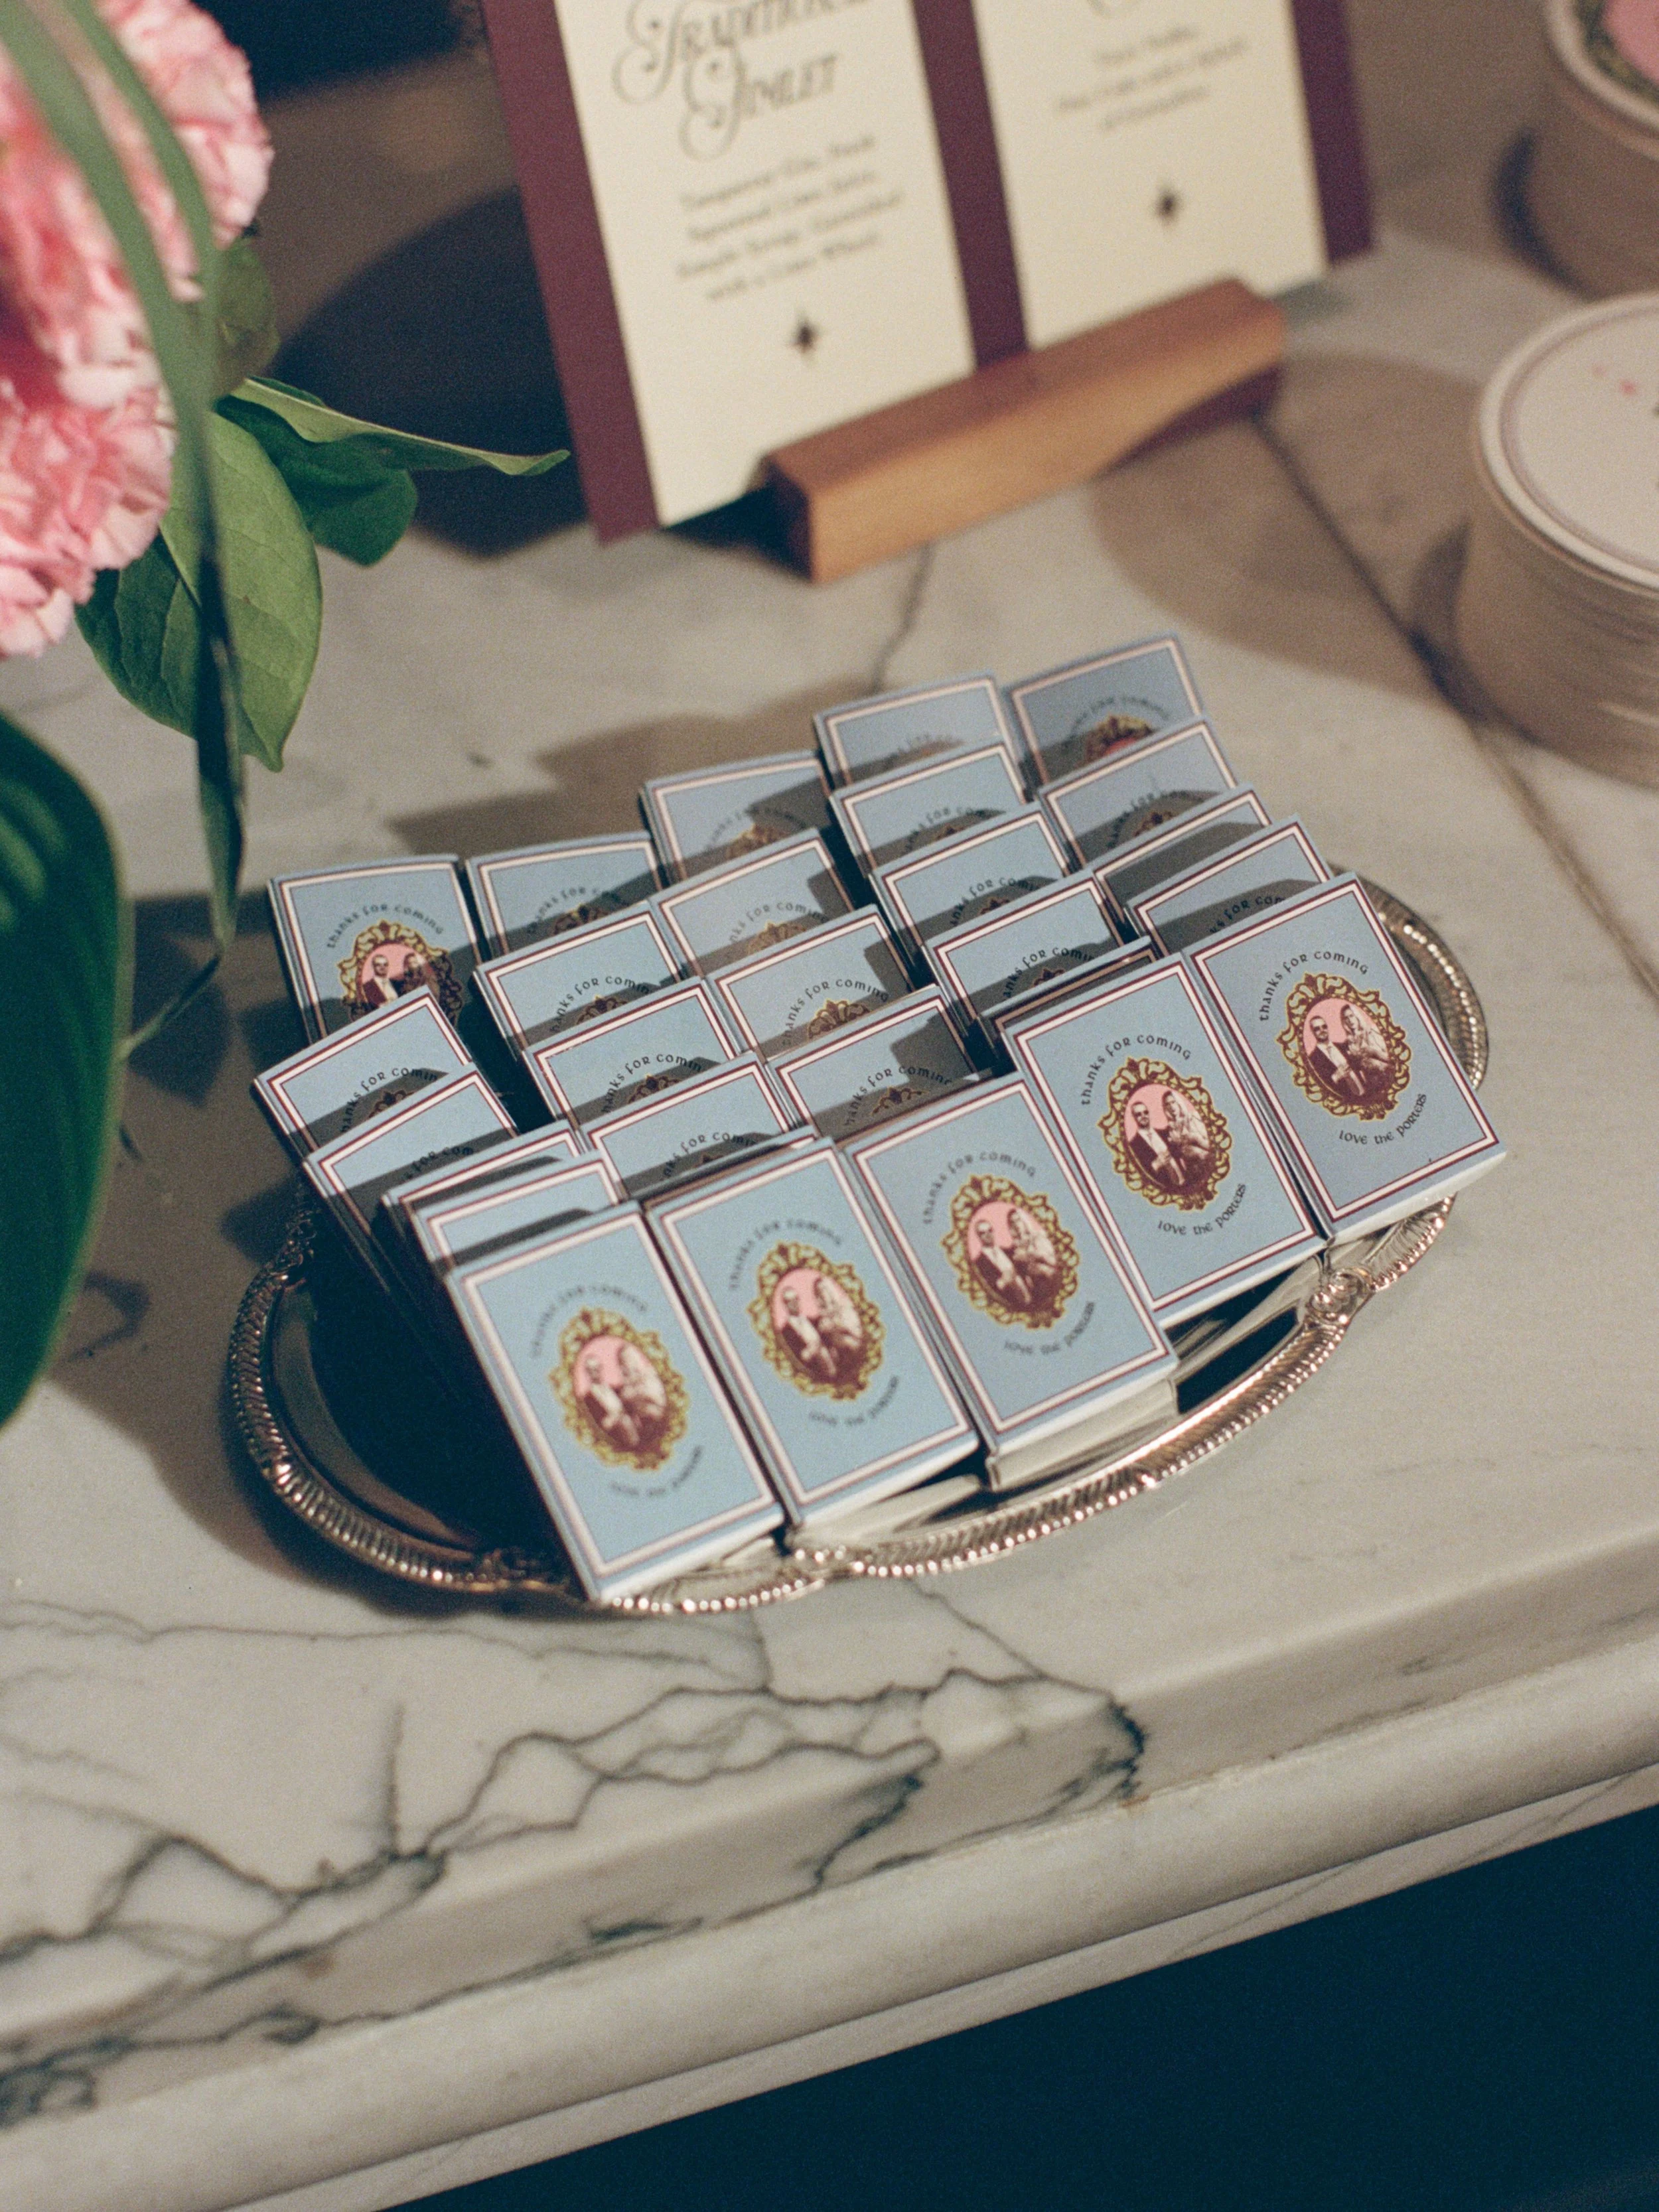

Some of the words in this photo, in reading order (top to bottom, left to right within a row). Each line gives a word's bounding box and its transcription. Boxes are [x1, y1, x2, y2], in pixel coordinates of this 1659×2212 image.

[605, 975, 650, 994] comin
[804, 981, 830, 999] for
[835, 979, 889, 1003] coming
[1260, 972, 1283, 1021] thanks
[1283, 953, 1308, 974] for
[1315, 951, 1369, 975] coming
[624, 1056, 650, 1075] for
[656, 1054, 702, 1072] comin
[1081, 1056, 1106, 1105] thanks
[1106, 1035, 1131, 1058] for
[1137, 1034, 1192, 1061] coming
[360, 1071, 385, 1091] for
[390, 1067, 439, 1081] comin
[867, 1068, 892, 1087] for
[1374, 1132, 1395, 1144] the
[979, 1150, 1036, 1178] coming
[1193, 1222, 1213, 1235] the
